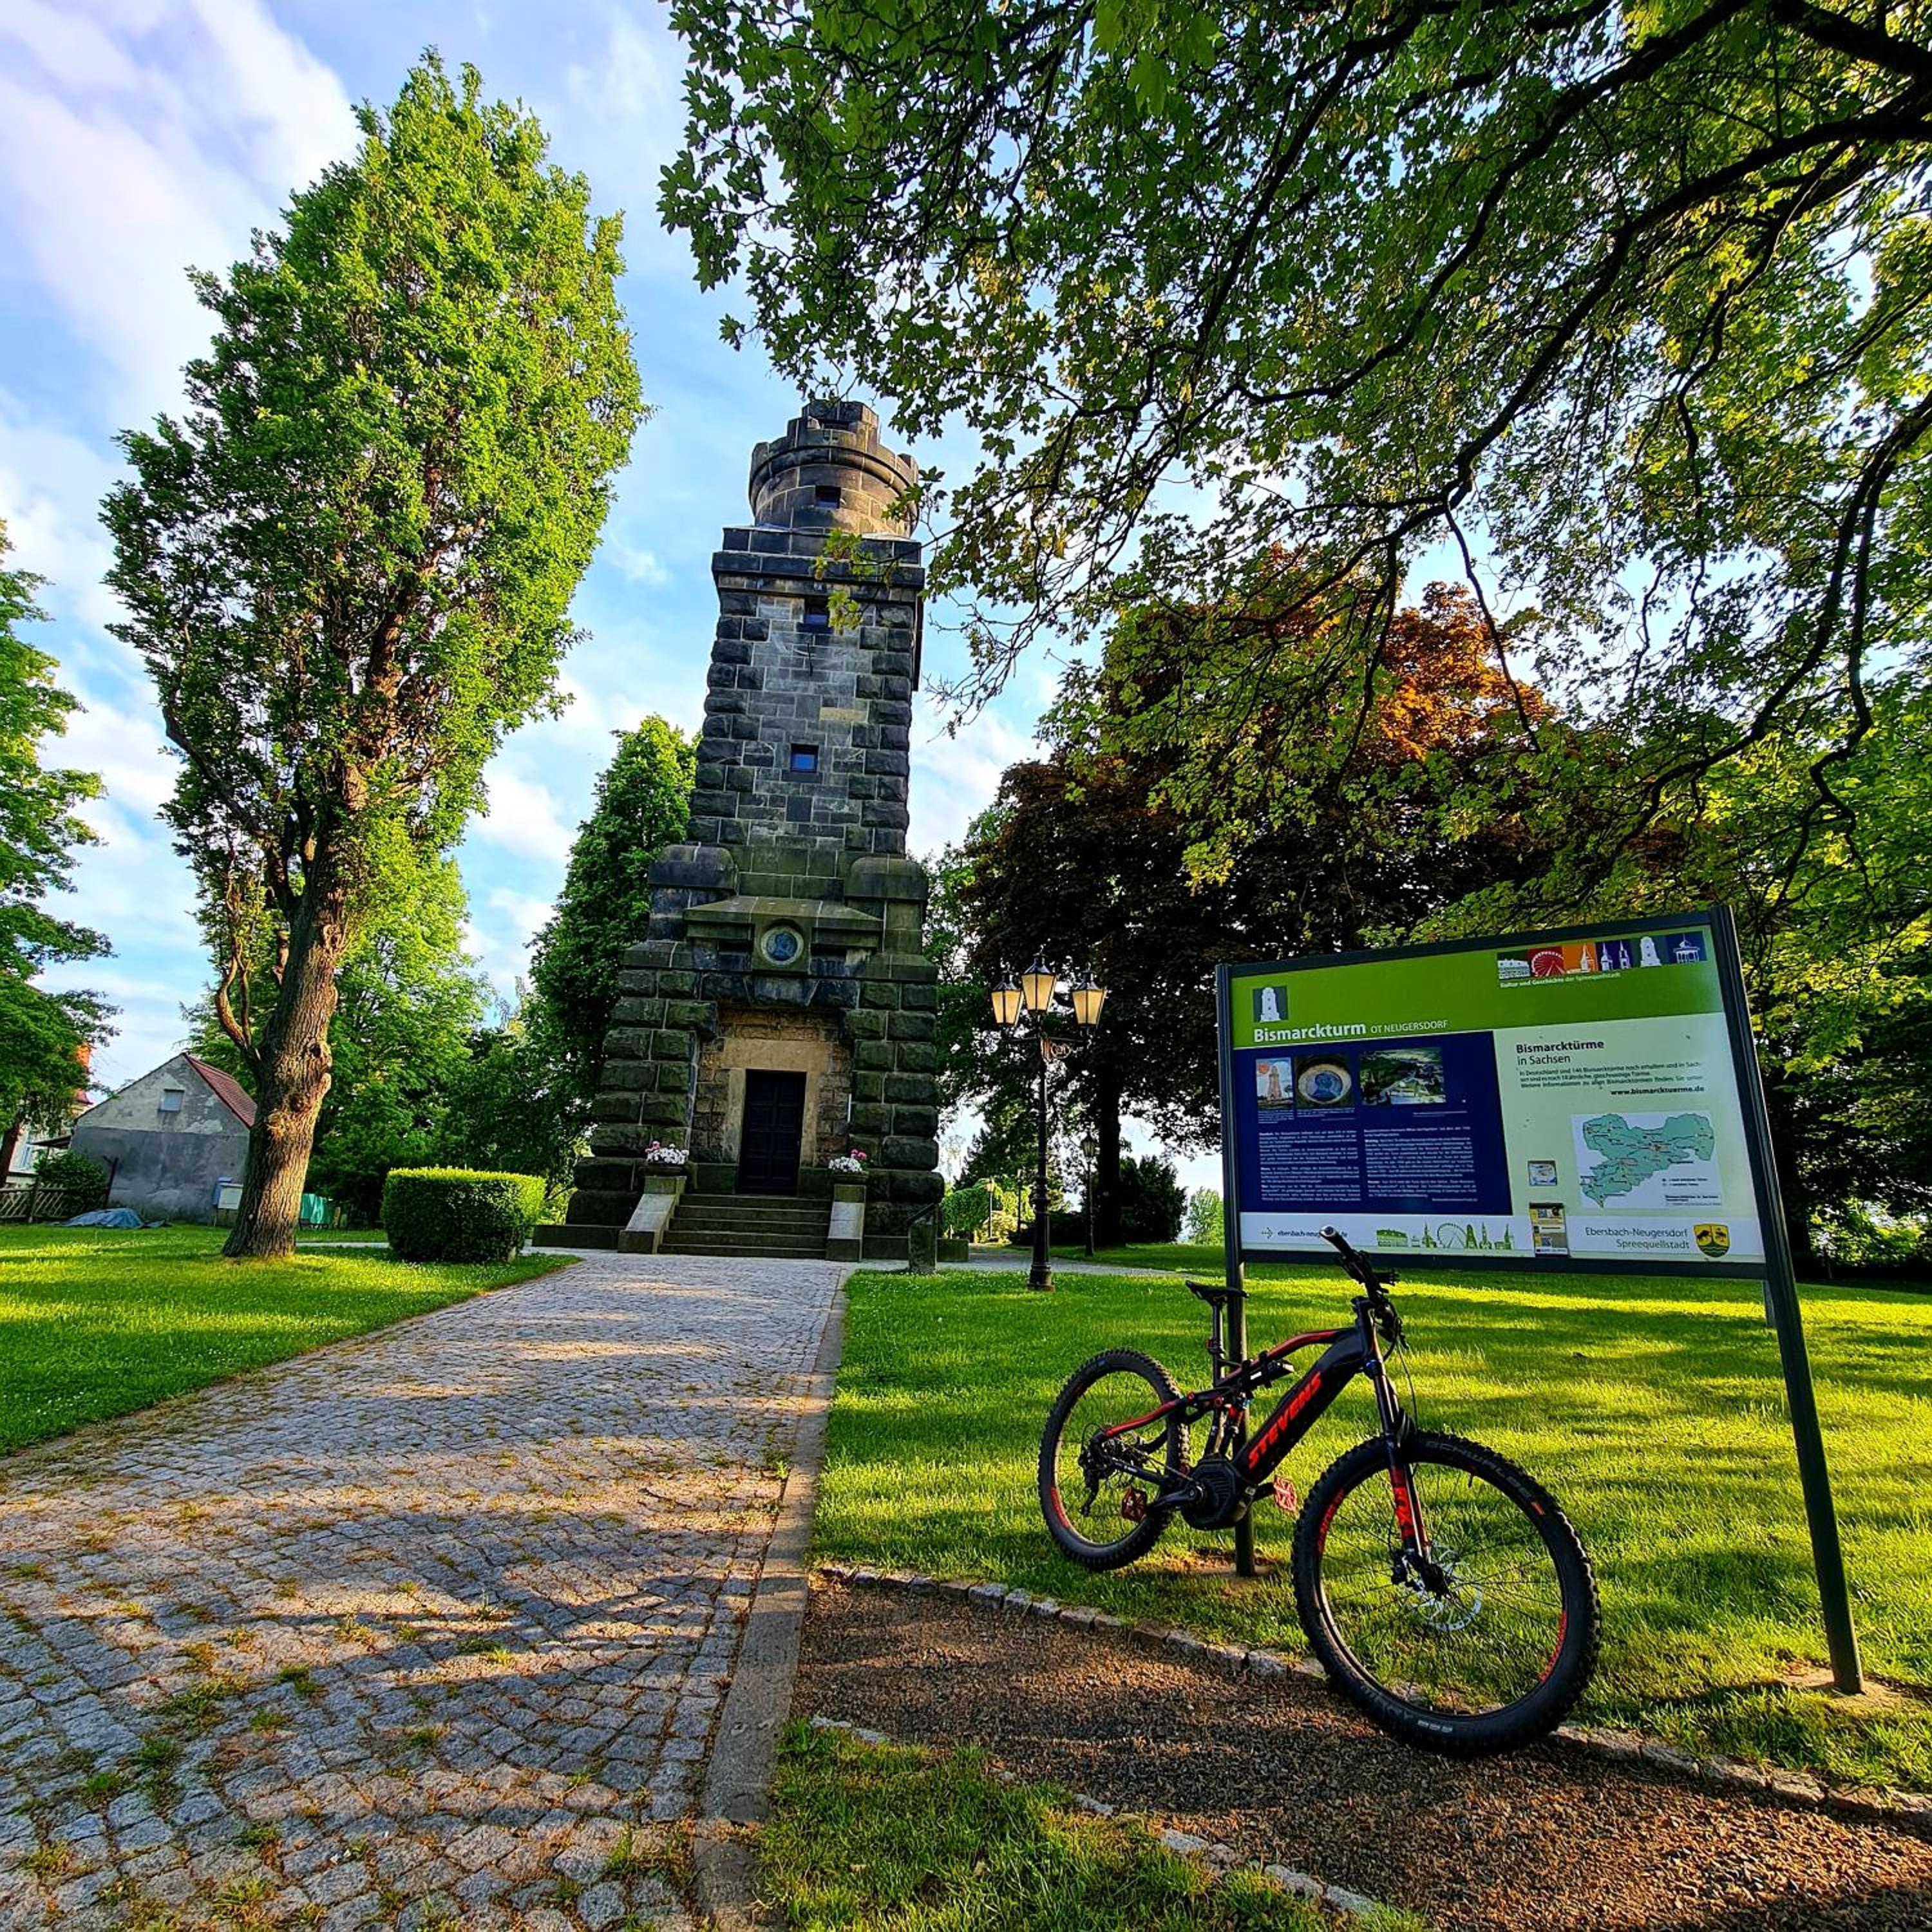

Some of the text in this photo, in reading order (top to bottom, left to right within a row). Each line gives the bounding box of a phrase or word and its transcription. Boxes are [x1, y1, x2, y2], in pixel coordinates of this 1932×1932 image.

[1253, 1019, 1448, 1042] Bismarckturm OT NEUGERSDORF
[1516, 1040, 1604, 1054] Bismarcktürme
[1517, 1054, 1571, 1065] in Sachsen
[1610, 1085, 1705, 1095] www.bismarcktuerme.de
[1586, 1227, 1688, 1238] Ebersbach-Neugersdorf
[1616, 1239, 1690, 1249] Spreequellstadt
[1249, 1371, 1321, 1470] STEVENS
